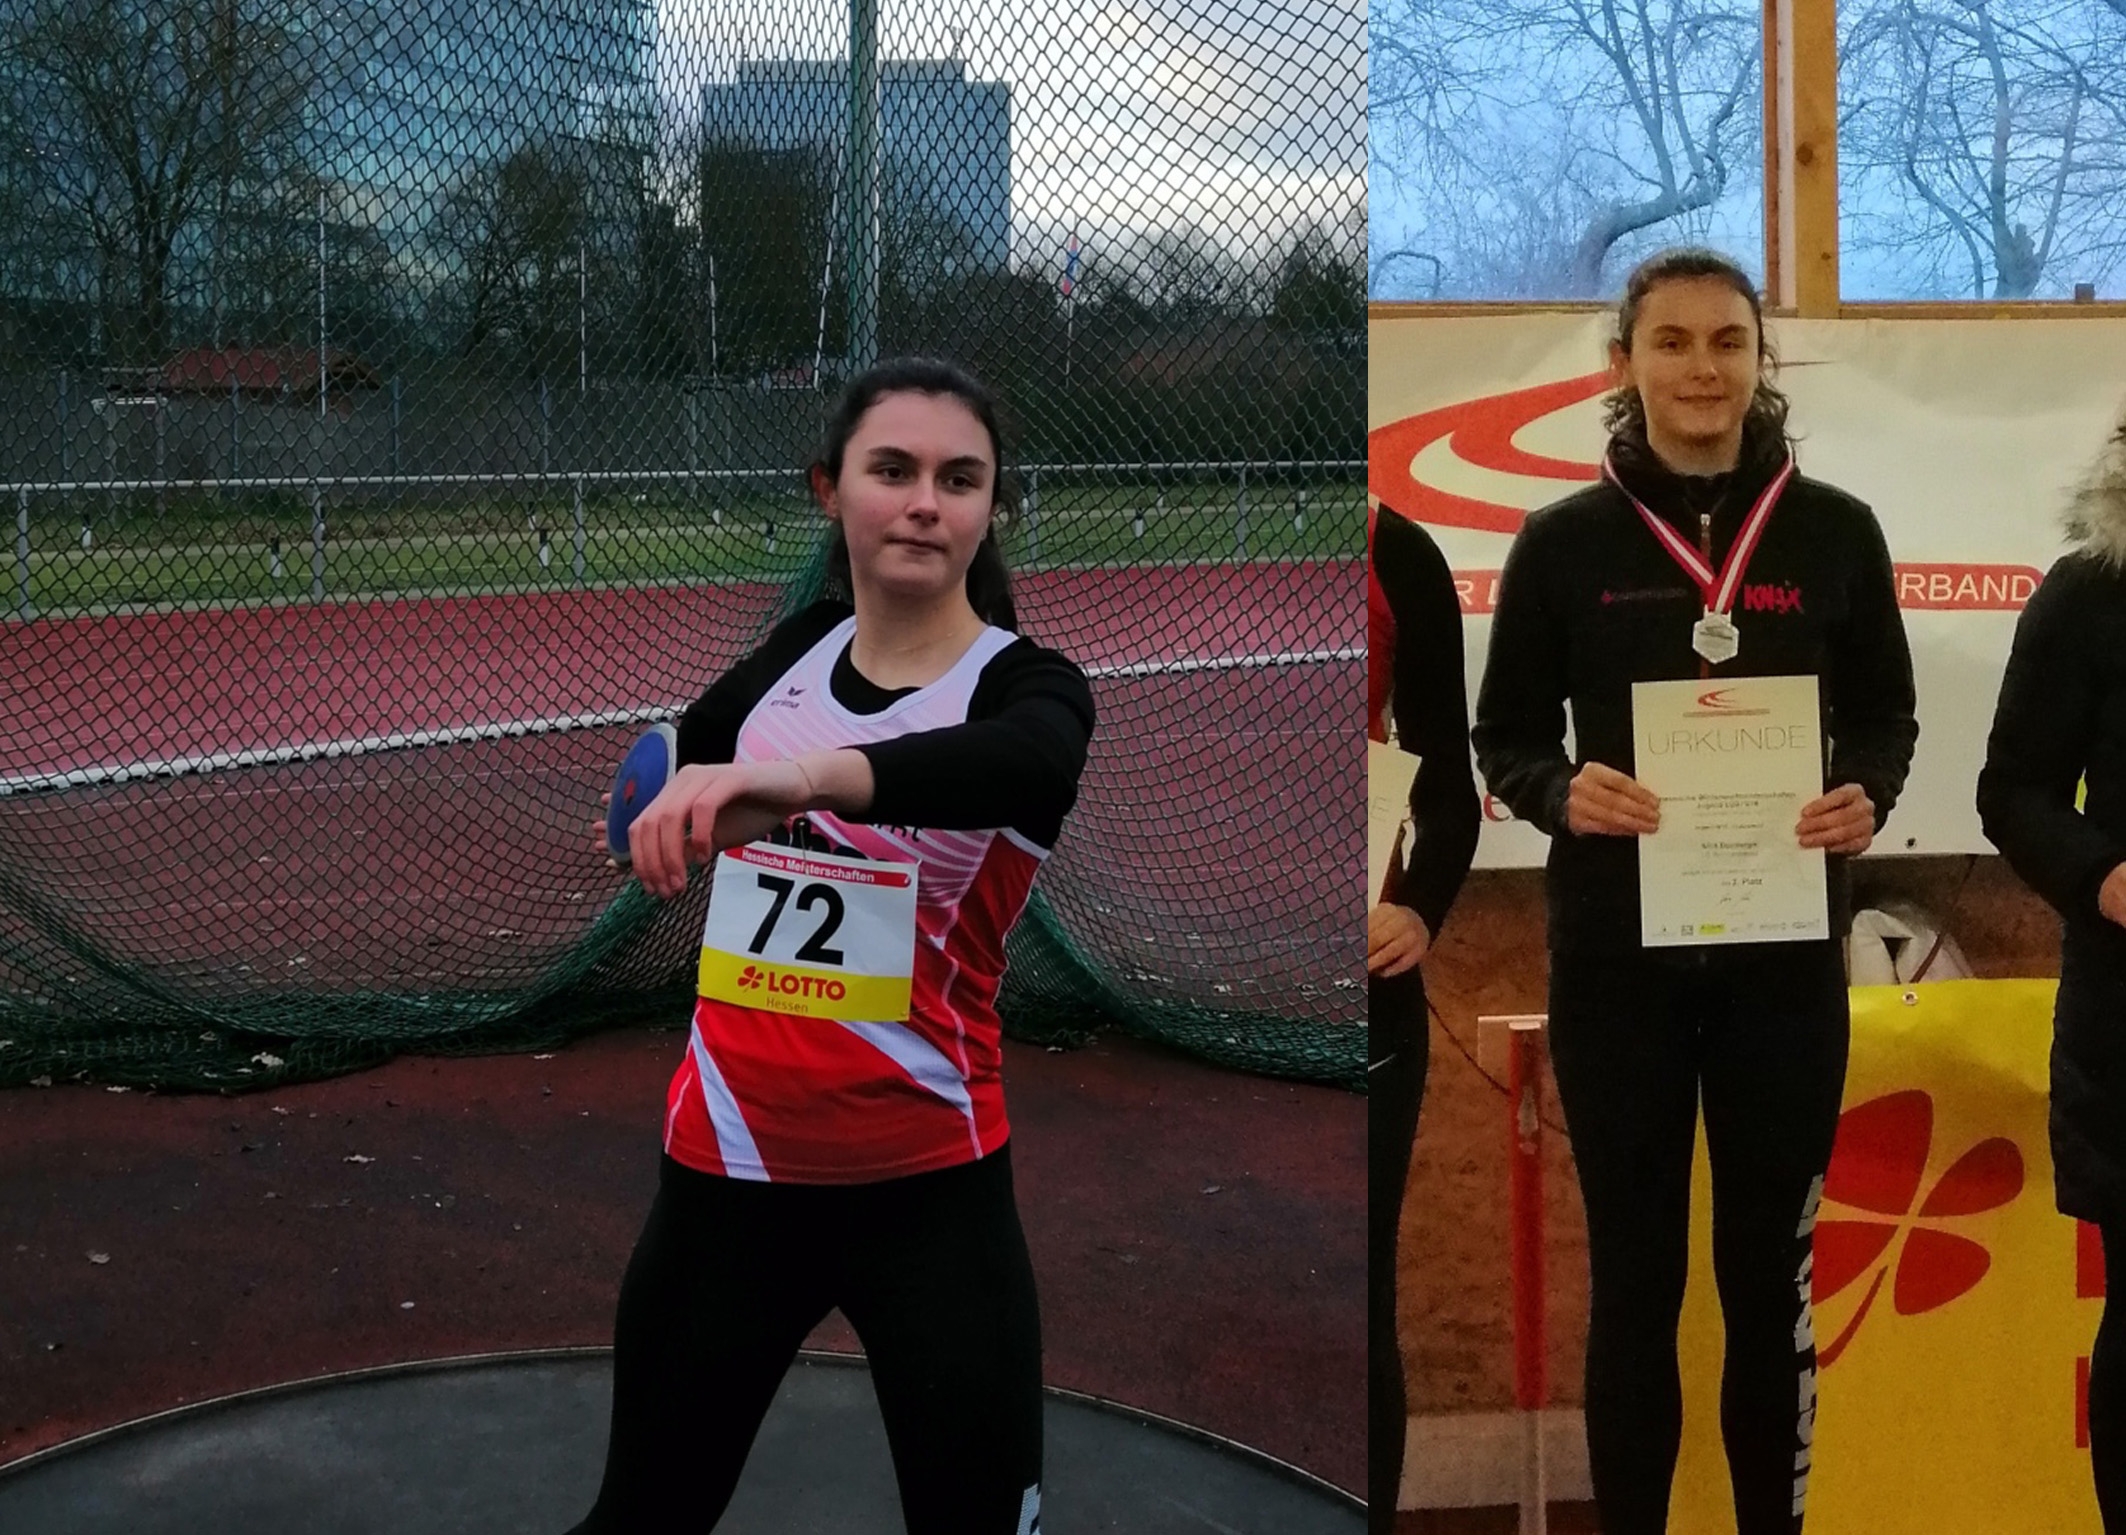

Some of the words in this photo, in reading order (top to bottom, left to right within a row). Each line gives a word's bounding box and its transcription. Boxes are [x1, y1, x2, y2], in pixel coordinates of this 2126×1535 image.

[1894, 572, 2037, 602] RBAND
[1648, 725, 1808, 755] URKUNDE
[741, 849, 785, 869] Hessische
[786, 859, 876, 883] Meisterschaften
[747, 873, 846, 966] 72
[767, 972, 846, 1001] LOTTO
[766, 996, 809, 1014] Hessen
